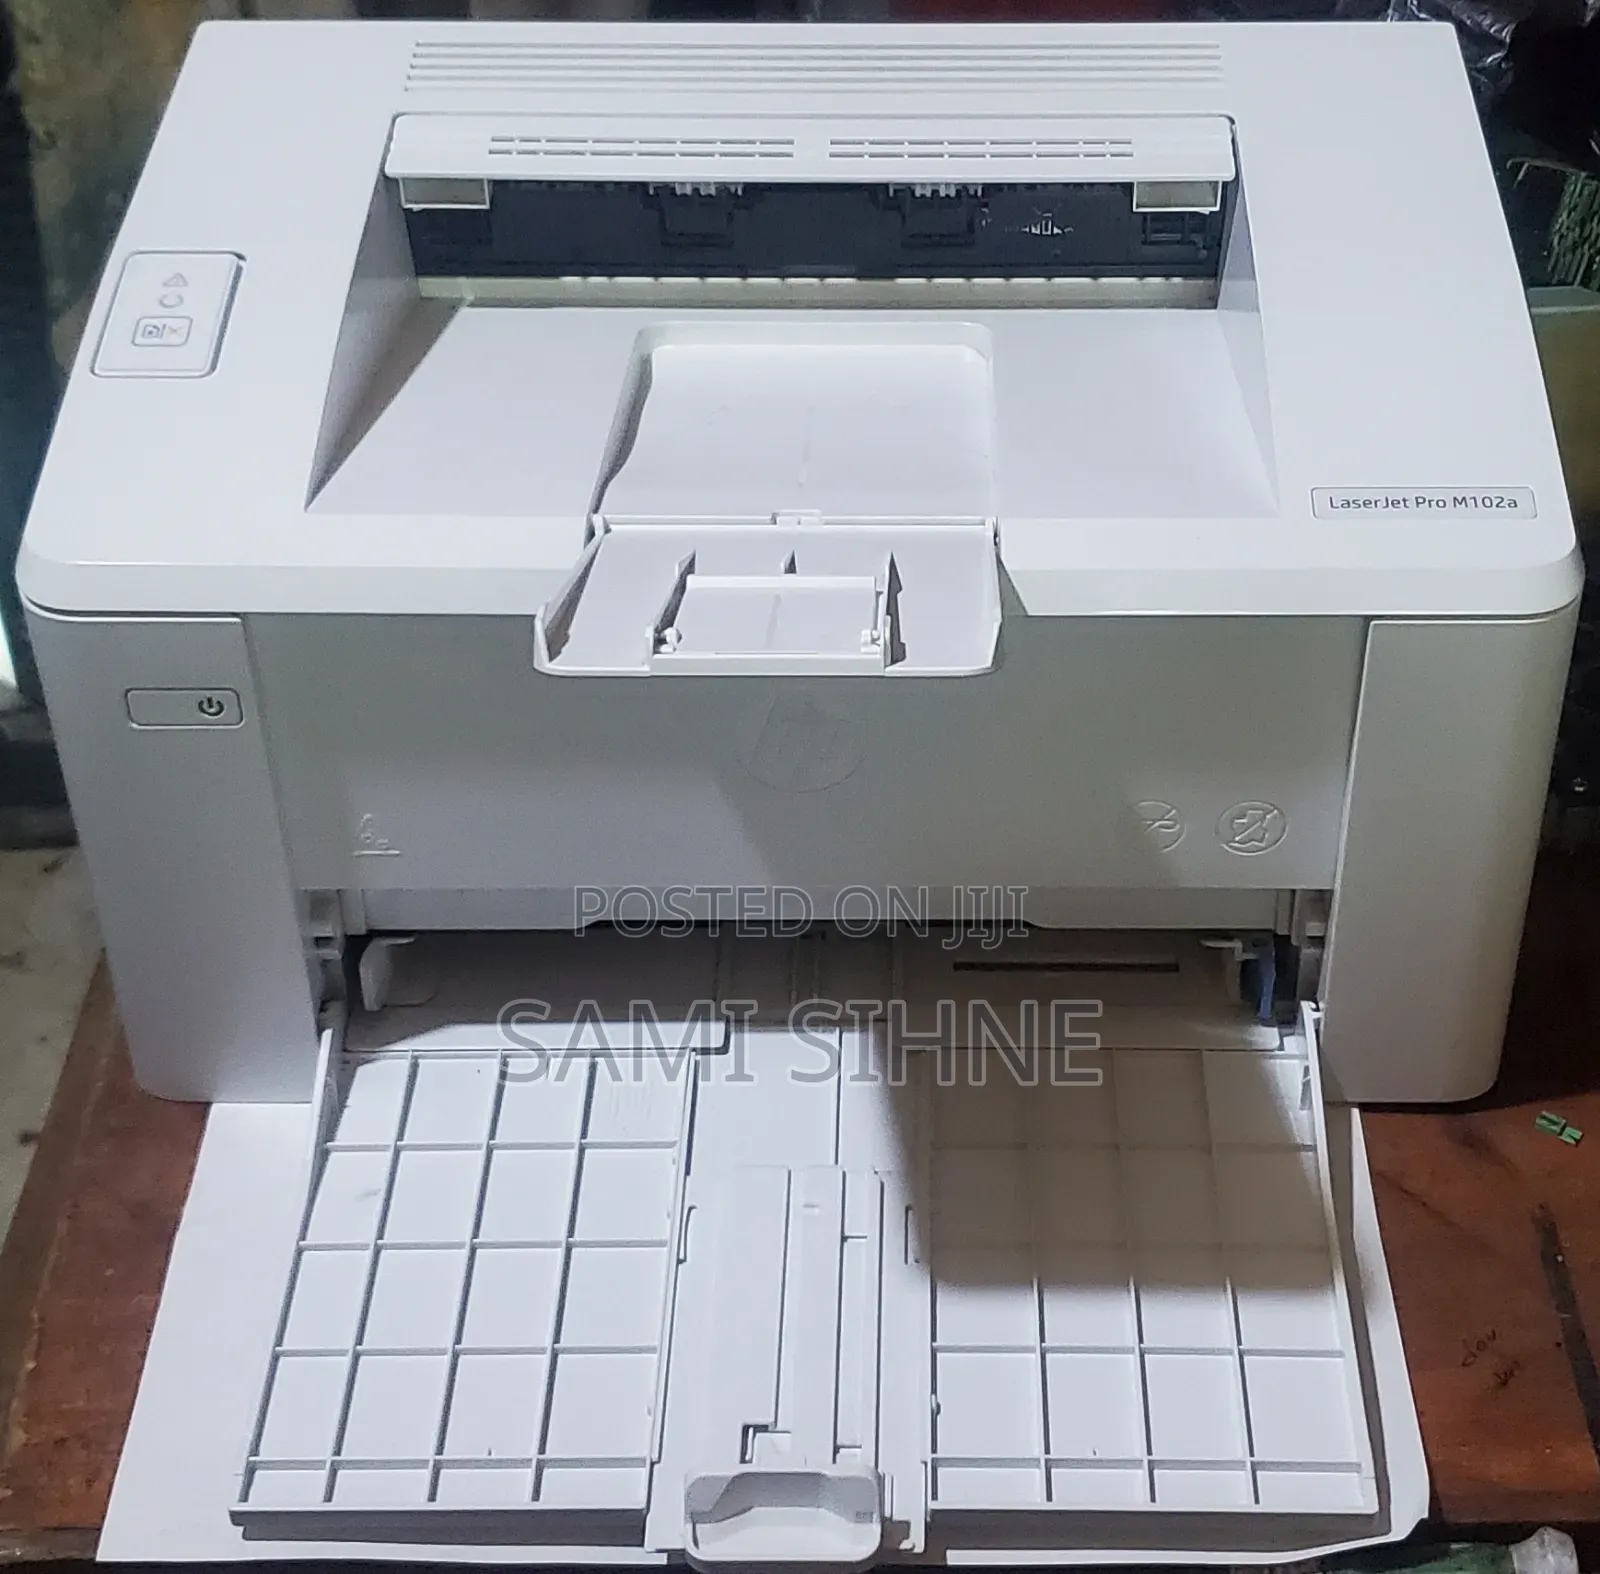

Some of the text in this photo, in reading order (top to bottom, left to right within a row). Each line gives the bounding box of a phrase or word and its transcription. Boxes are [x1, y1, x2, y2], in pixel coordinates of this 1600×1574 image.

[1329, 496, 1518, 509] LaserJet Pro M102a
